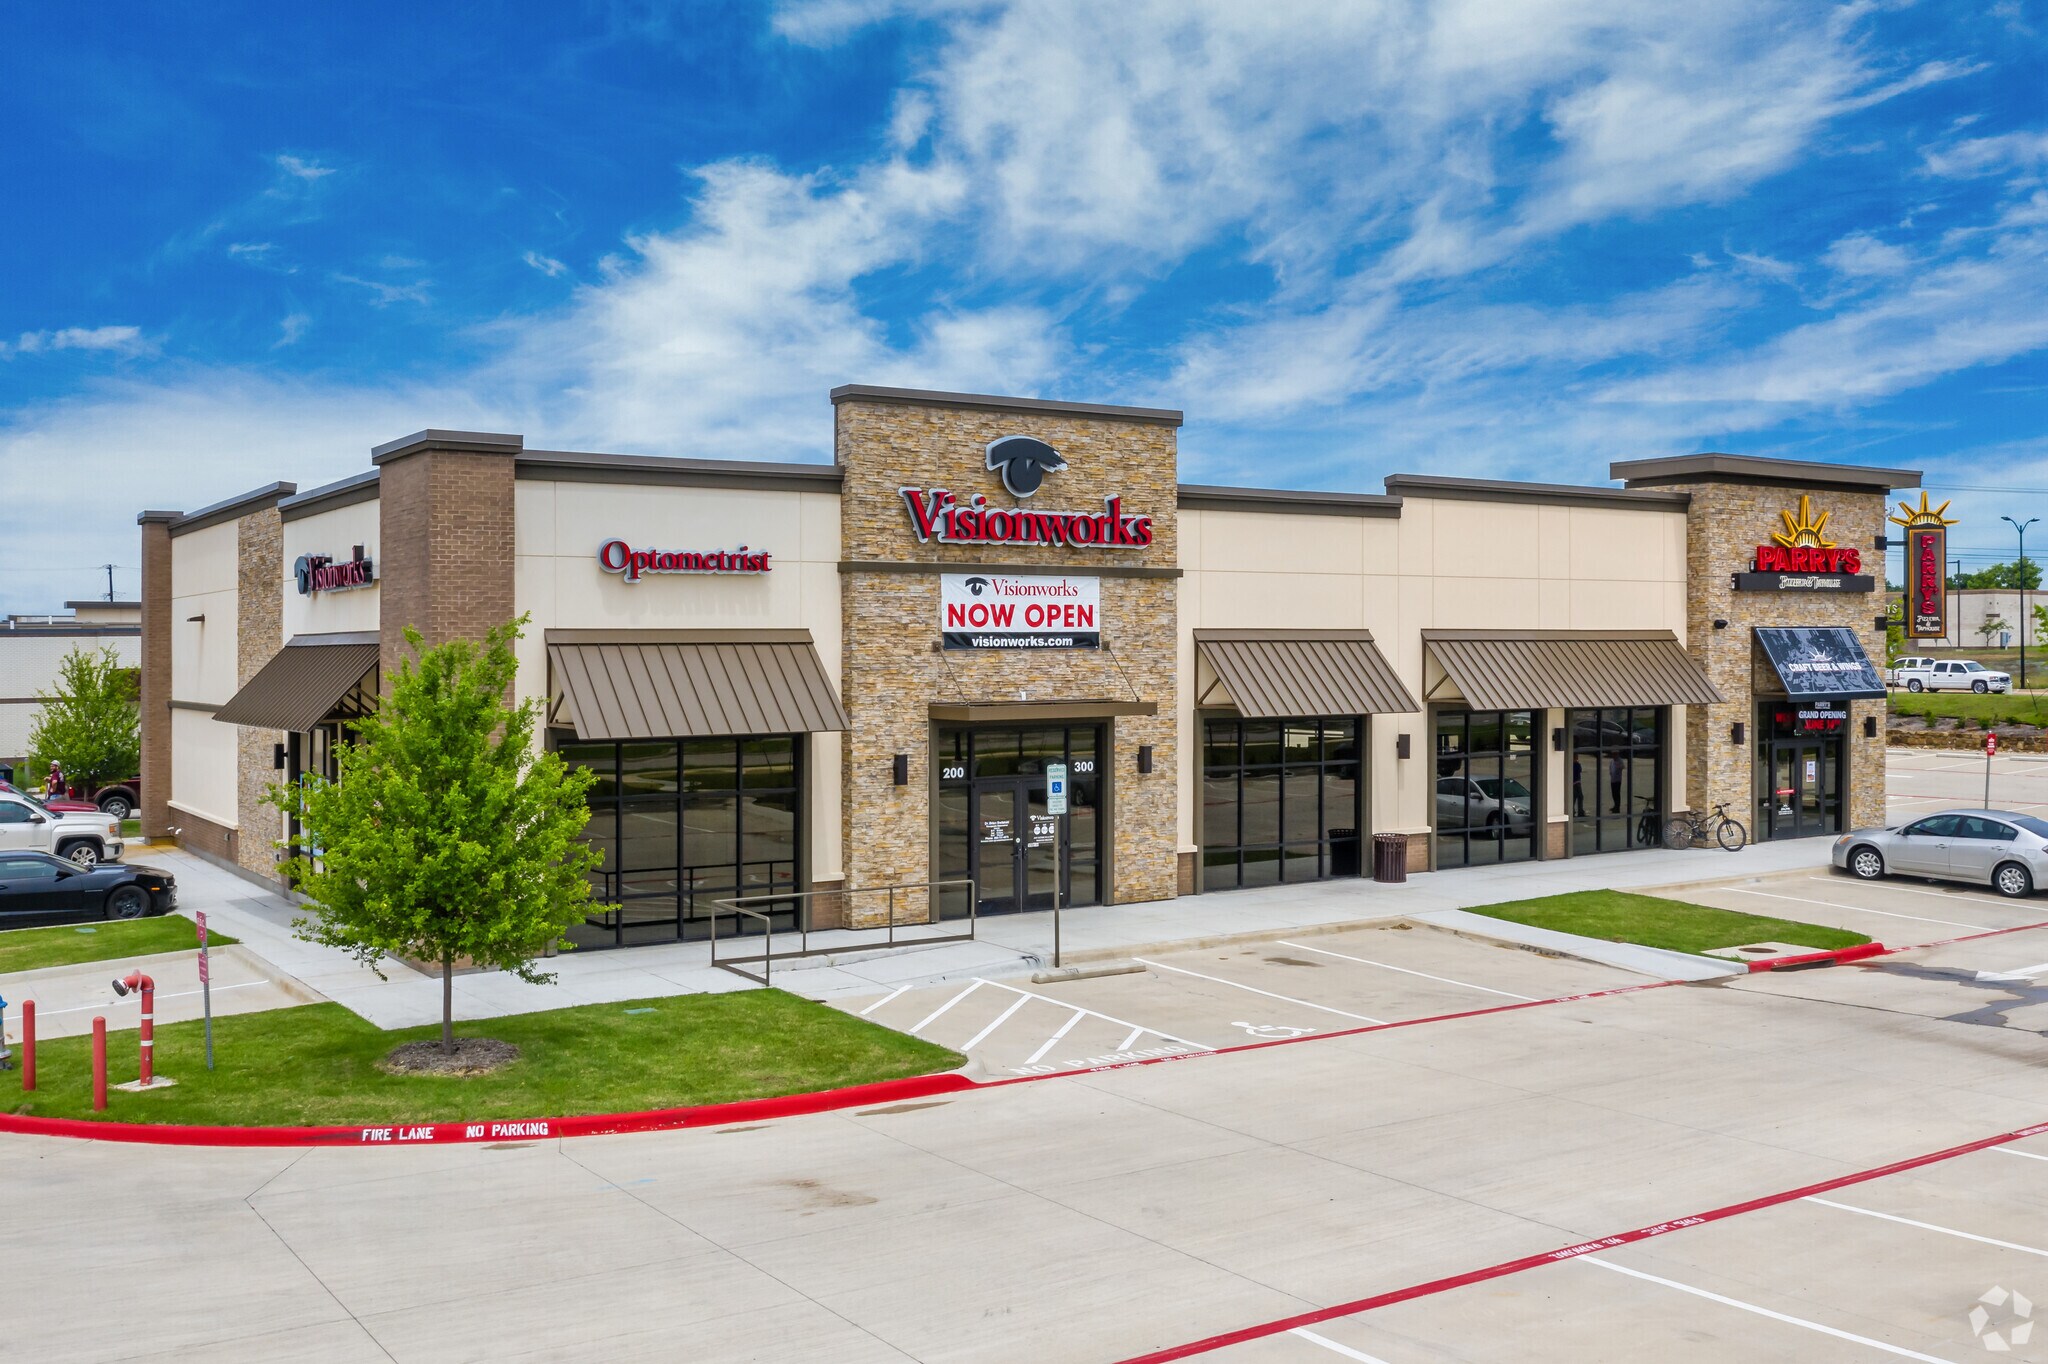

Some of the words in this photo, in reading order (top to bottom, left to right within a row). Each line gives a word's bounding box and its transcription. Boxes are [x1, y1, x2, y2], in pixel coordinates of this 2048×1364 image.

[901, 490, 1152, 546] Visionworks
[601, 540, 772, 579] Optometrist
[1757, 546, 1861, 573] PARRY'S
[1920, 535, 1938, 614] PARRY'S
[991, 578, 1078, 597] Visionworks
[948, 603, 1015, 627] NOW
[1024, 604, 1094, 627] OPEN
[972, 635, 1073, 647] visionworks.com
[1788, 663, 1813, 672] CRAFT
[1812, 663, 1832, 671] BEER
[1837, 661, 1862, 670] WINGS
[1798, 711, 1819, 719] GRAND
[1820, 710, 1846, 719] OPENING
[1804, 719, 1825, 730] JUNE
[943, 767, 964, 779] 200
[1074, 761, 1094, 772] 300
[1008, 1064, 1056, 1076] NO
[1063, 1045, 1189, 1068] PARKING
[362, 1128, 393, 1142] FIRE
[399, 1127, 434, 1140] LANE
[466, 1125, 485, 1138] NO
[491, 1122, 549, 1137] PARKING
